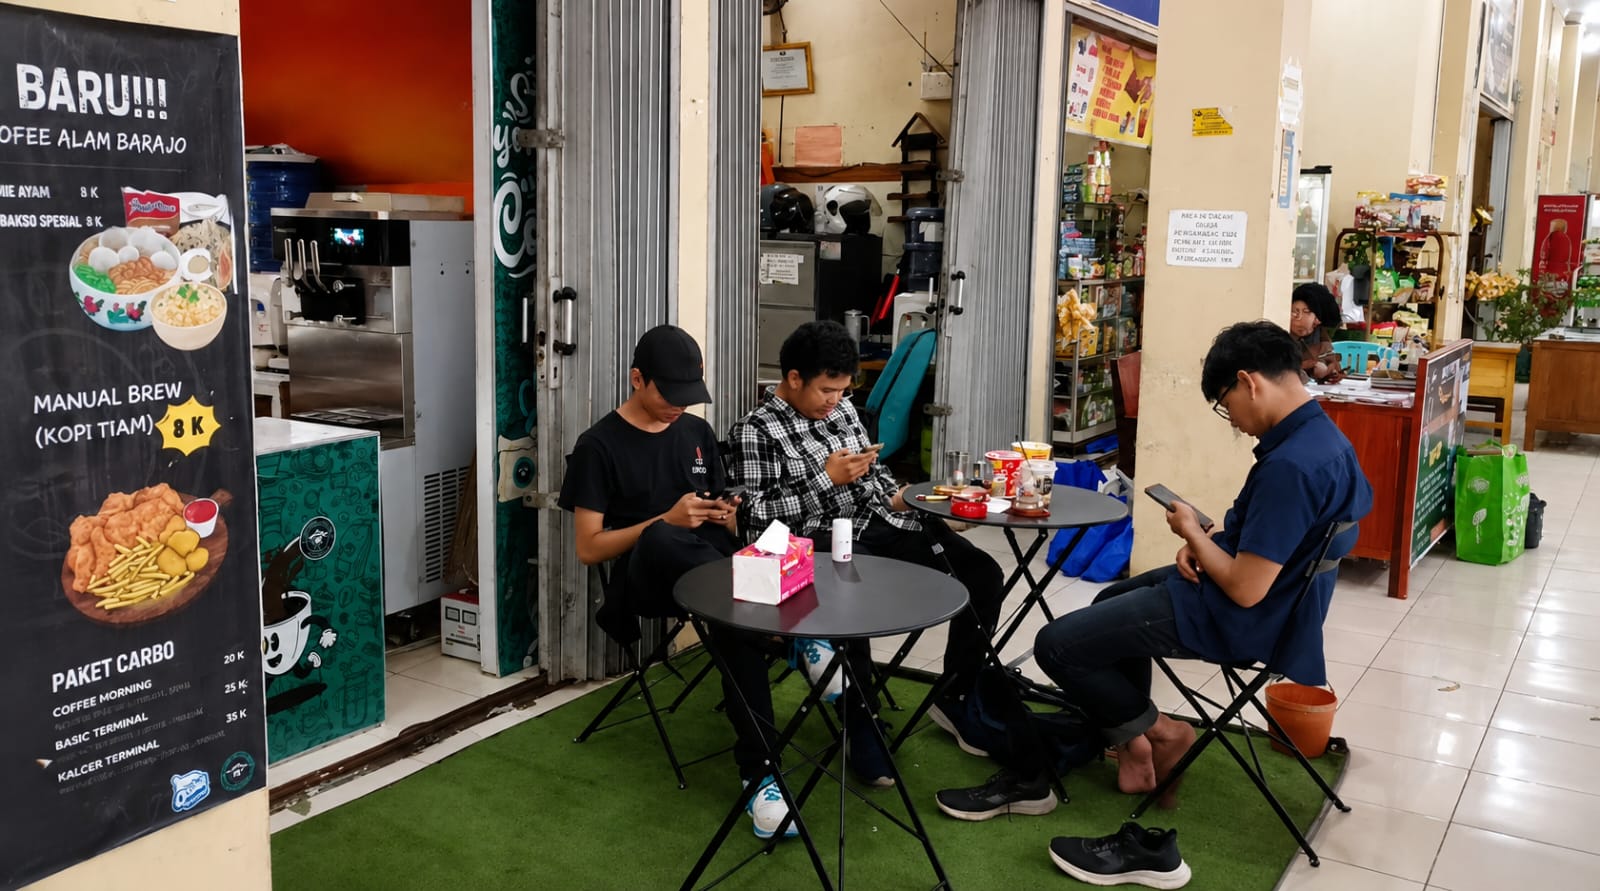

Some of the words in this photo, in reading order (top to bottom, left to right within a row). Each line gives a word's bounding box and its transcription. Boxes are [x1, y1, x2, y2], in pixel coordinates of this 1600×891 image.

[16, 63, 168, 120] BARU!!!
[57, 129, 111, 152] ALAM
[116, 132, 187, 154] BARAJO
[18, 185, 50, 198] AYAM
[80, 186, 87, 198] 8
[90, 186, 99, 198] K
[0, 215, 36, 228] BAKSO
[39, 215, 82, 228] SPESIAL
[86, 216, 93, 228] 8
[95, 215, 103, 228] K
[34, 388, 122, 414] MANUAL
[128, 381, 182, 403] BREW
[35, 423, 93, 449] (KOPI
[98, 414, 153, 438] TIAM)
[173, 419, 185, 438] 8
[192, 416, 204, 436] K
[52, 658, 112, 693] PAKET
[116, 640, 175, 674] CARBO
[223, 654, 235, 664] 20
[237, 650, 245, 660] K
[52, 696, 97, 718] COFFEE
[99, 679, 153, 704] MORNING
[224, 684, 236, 694] 25
[226, 712, 238, 723] 35
[239, 708, 248, 719] K
[55, 731, 90, 751] BASIC
[93, 712, 149, 737] TERMINAL
[57, 761, 103, 783] KALCER
[105, 739, 160, 766] TERMINAL
